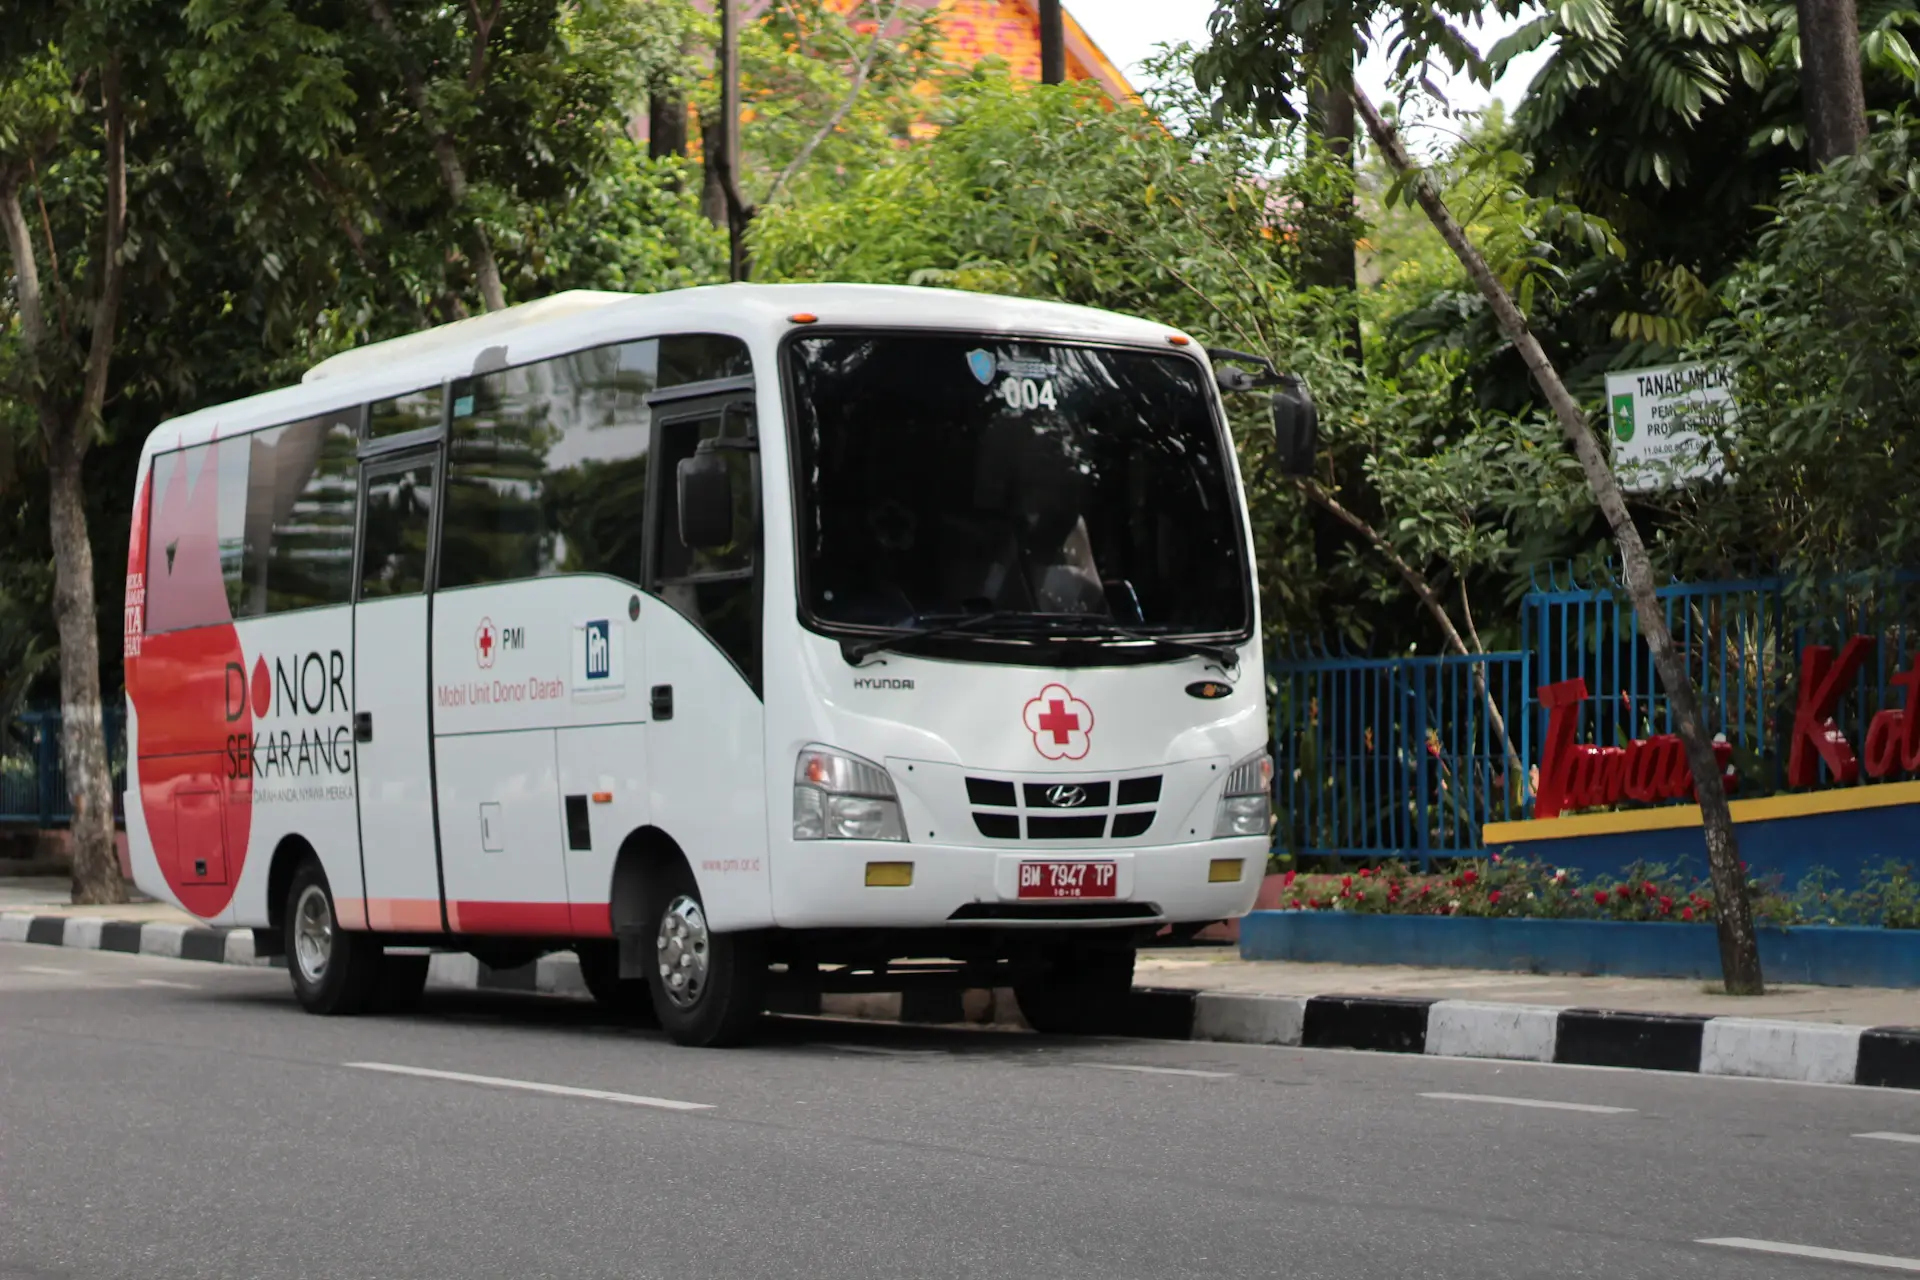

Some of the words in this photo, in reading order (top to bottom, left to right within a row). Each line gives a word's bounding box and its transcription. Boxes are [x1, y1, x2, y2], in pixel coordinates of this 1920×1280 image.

[1003, 377, 1057, 411] 004
[1637, 371, 1683, 397] TANAH
[503, 627, 525, 650] PMI
[438, 685, 466, 707] Mobil
[468, 681, 490, 705] Unit
[493, 680, 526, 703] Donor
[530, 675, 564, 700] Darah
[854, 678, 915, 689] HYUNDAI
[226, 725, 351, 780] SEKARANG
[1021, 864, 1041, 887] BM
[1049, 864, 1086, 887] 7947
[1094, 864, 1114, 886] TP
